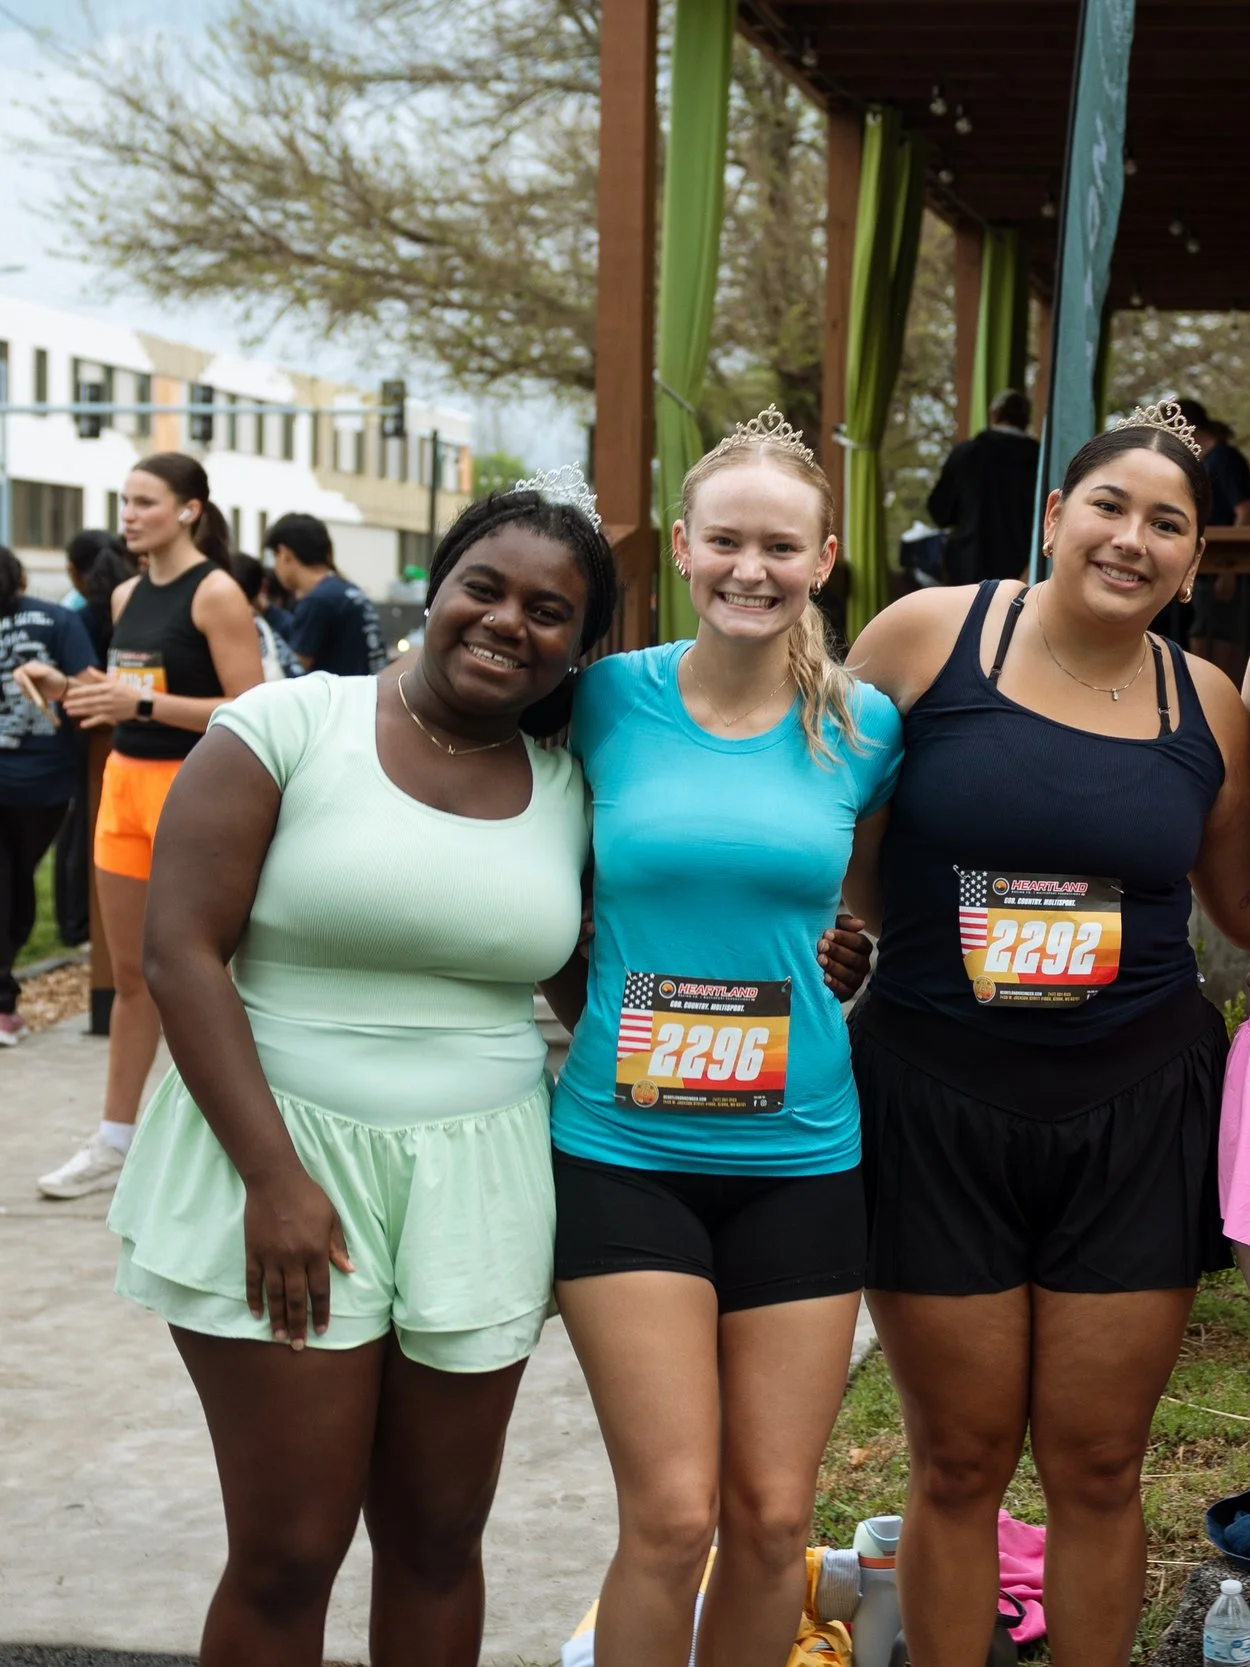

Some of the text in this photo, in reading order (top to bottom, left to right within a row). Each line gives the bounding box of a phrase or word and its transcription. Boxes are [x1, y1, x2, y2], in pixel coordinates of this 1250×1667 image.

[1011, 880, 1088, 893] HEARTLAND
[984, 919, 1103, 975] 2292
[678, 983, 758, 998] HEARTLAND
[684, 1001, 709, 1010] COUNTRY.
[647, 1023, 770, 1081] 2296
